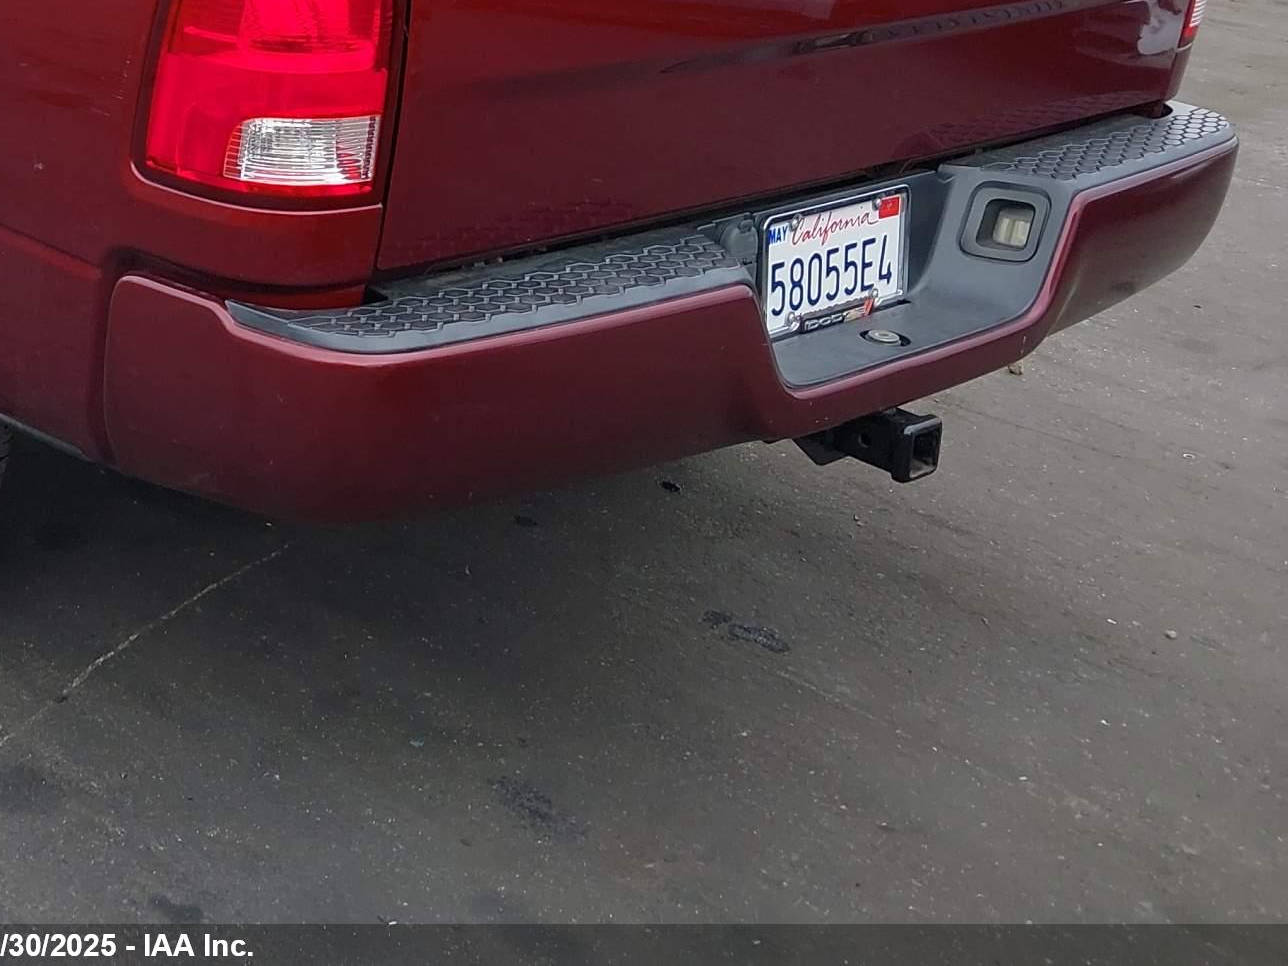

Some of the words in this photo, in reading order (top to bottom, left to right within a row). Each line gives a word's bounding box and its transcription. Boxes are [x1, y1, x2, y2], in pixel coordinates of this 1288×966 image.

[769, 226, 788, 245] MAY
[791, 211, 878, 246] California
[771, 235, 892, 316] 58055E4
